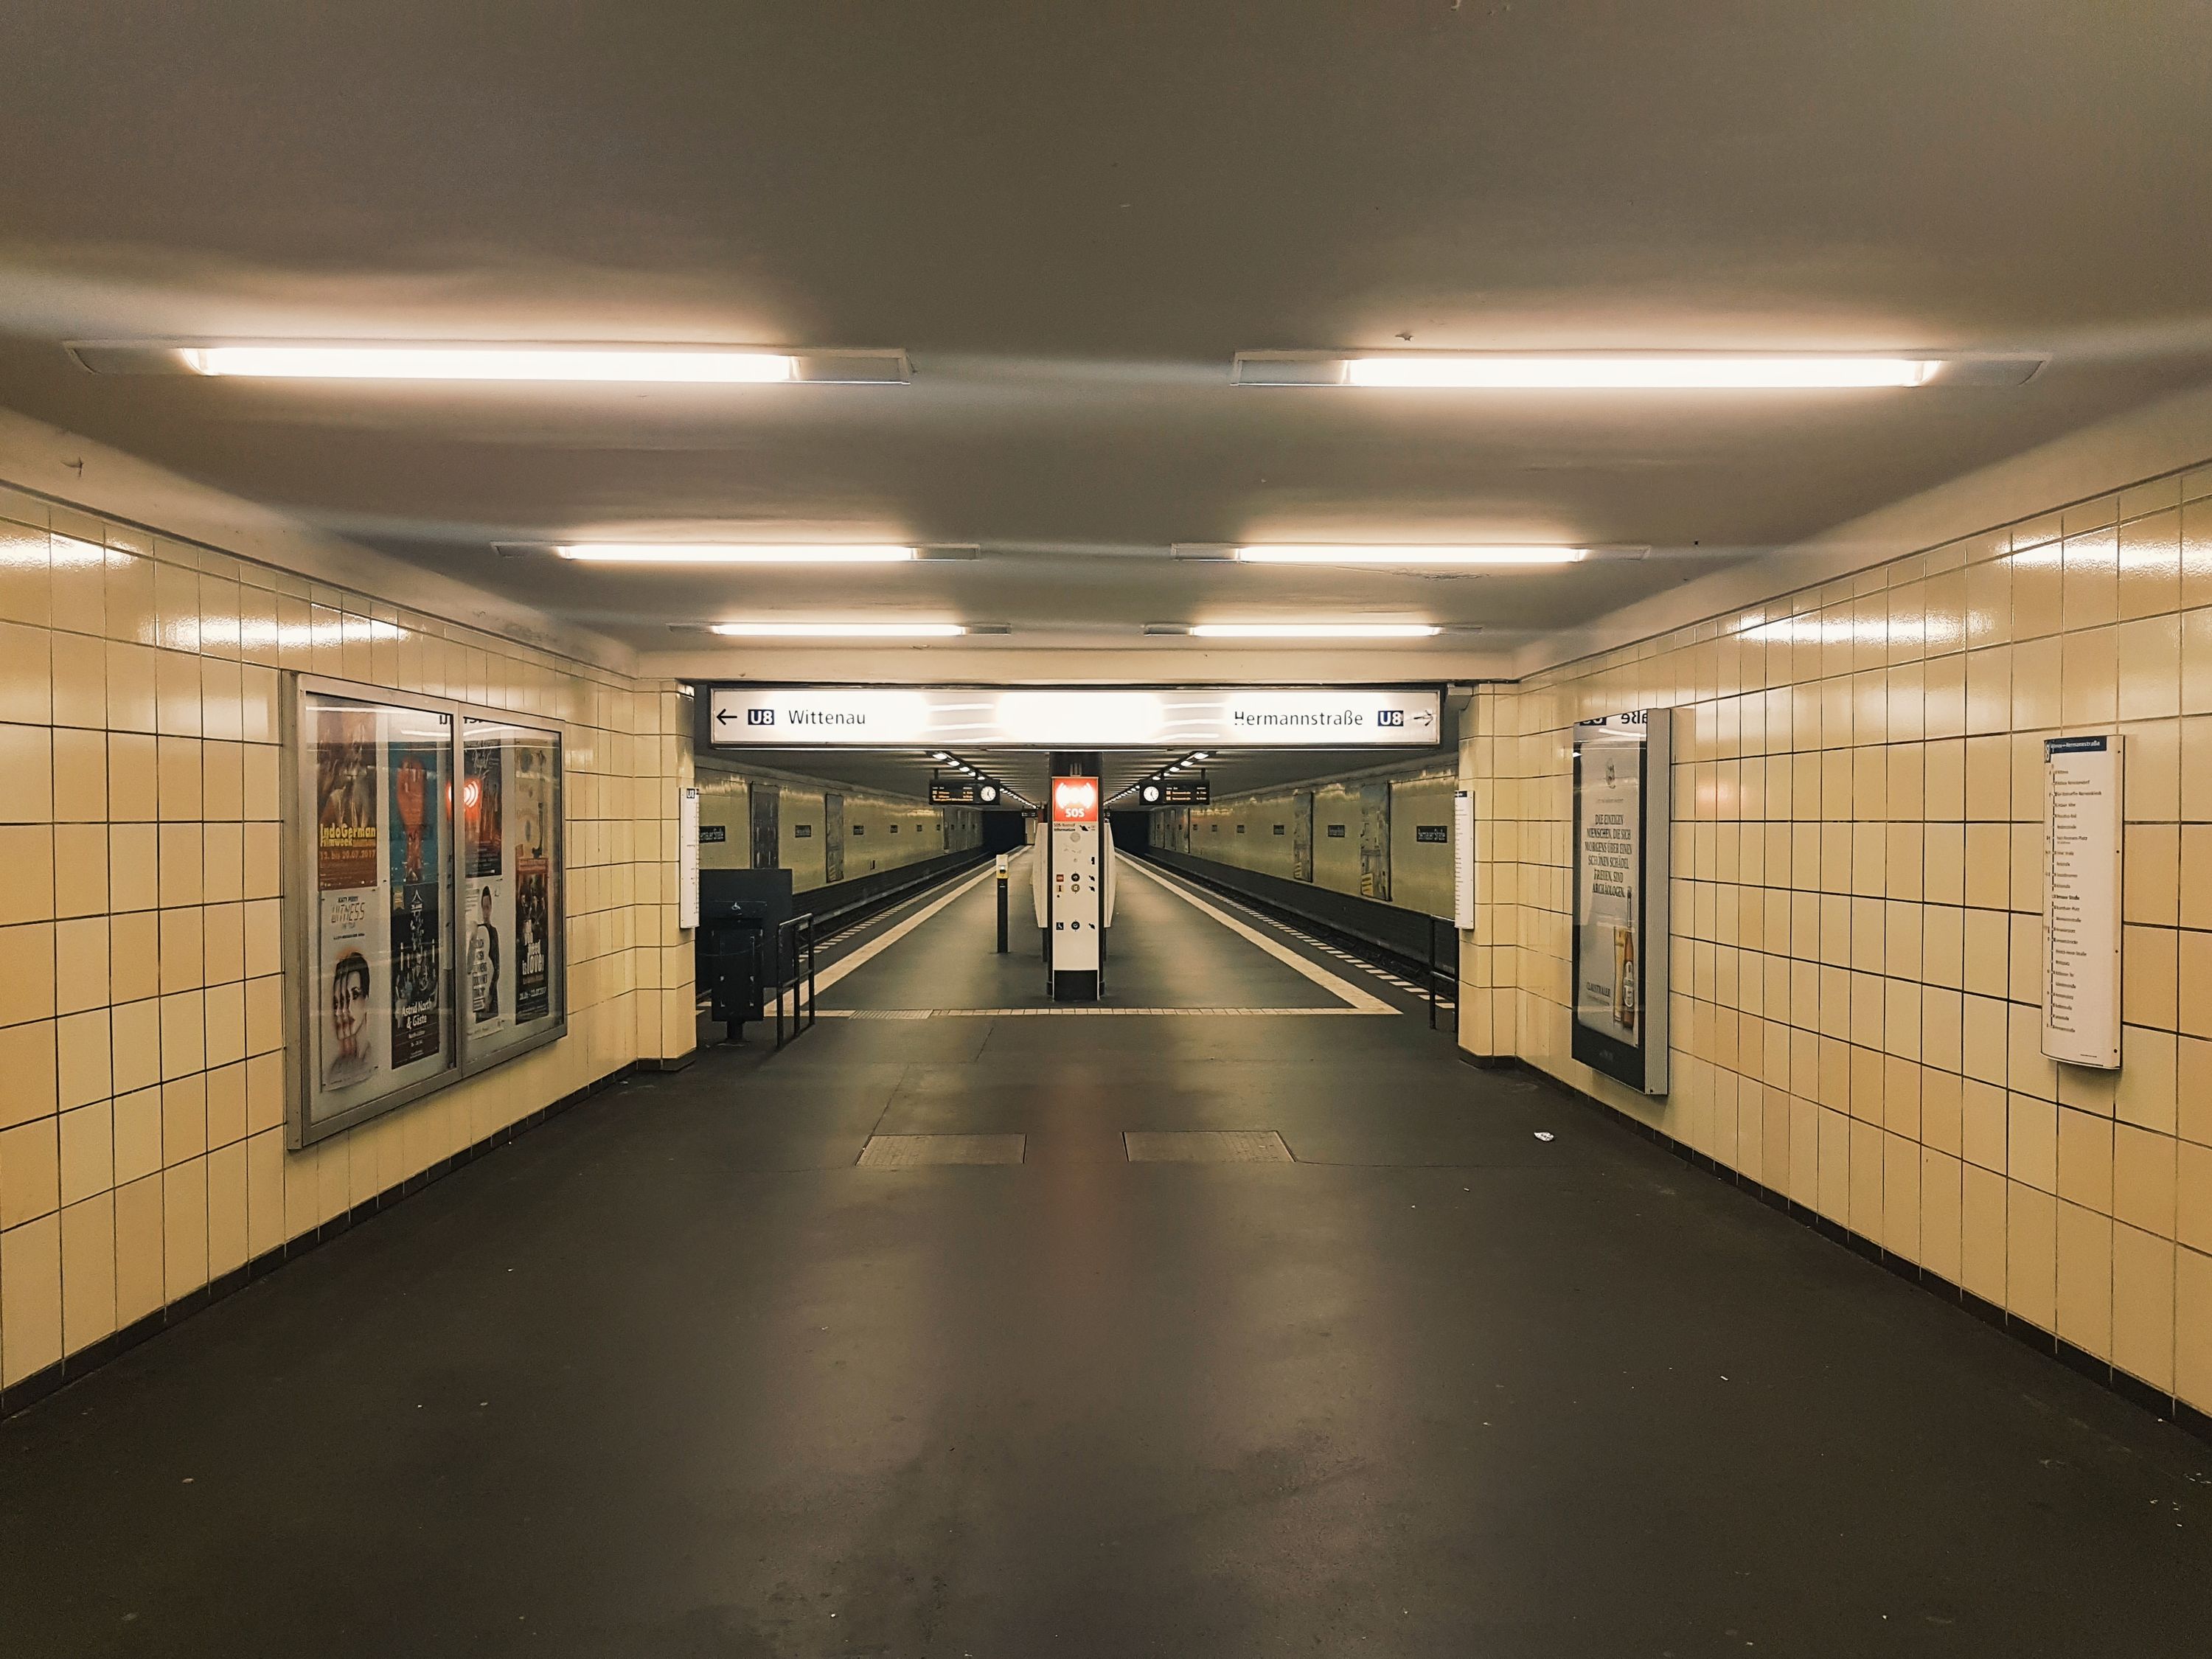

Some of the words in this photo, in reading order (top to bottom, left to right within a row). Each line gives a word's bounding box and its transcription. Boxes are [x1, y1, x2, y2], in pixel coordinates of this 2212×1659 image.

[750, 710, 773, 724] U8
[788, 709, 866, 725] Wittenau
[1234, 709, 1363, 726] Hermannstraße
[1380, 711, 1403, 726] U8
[1065, 808, 1085, 818] SOS
[320, 822, 376, 839] IndoGerman
[402, 1001, 418, 1017] Astrid
[418, 998, 432, 1013] North
[406, 1016, 412, 1030] &
